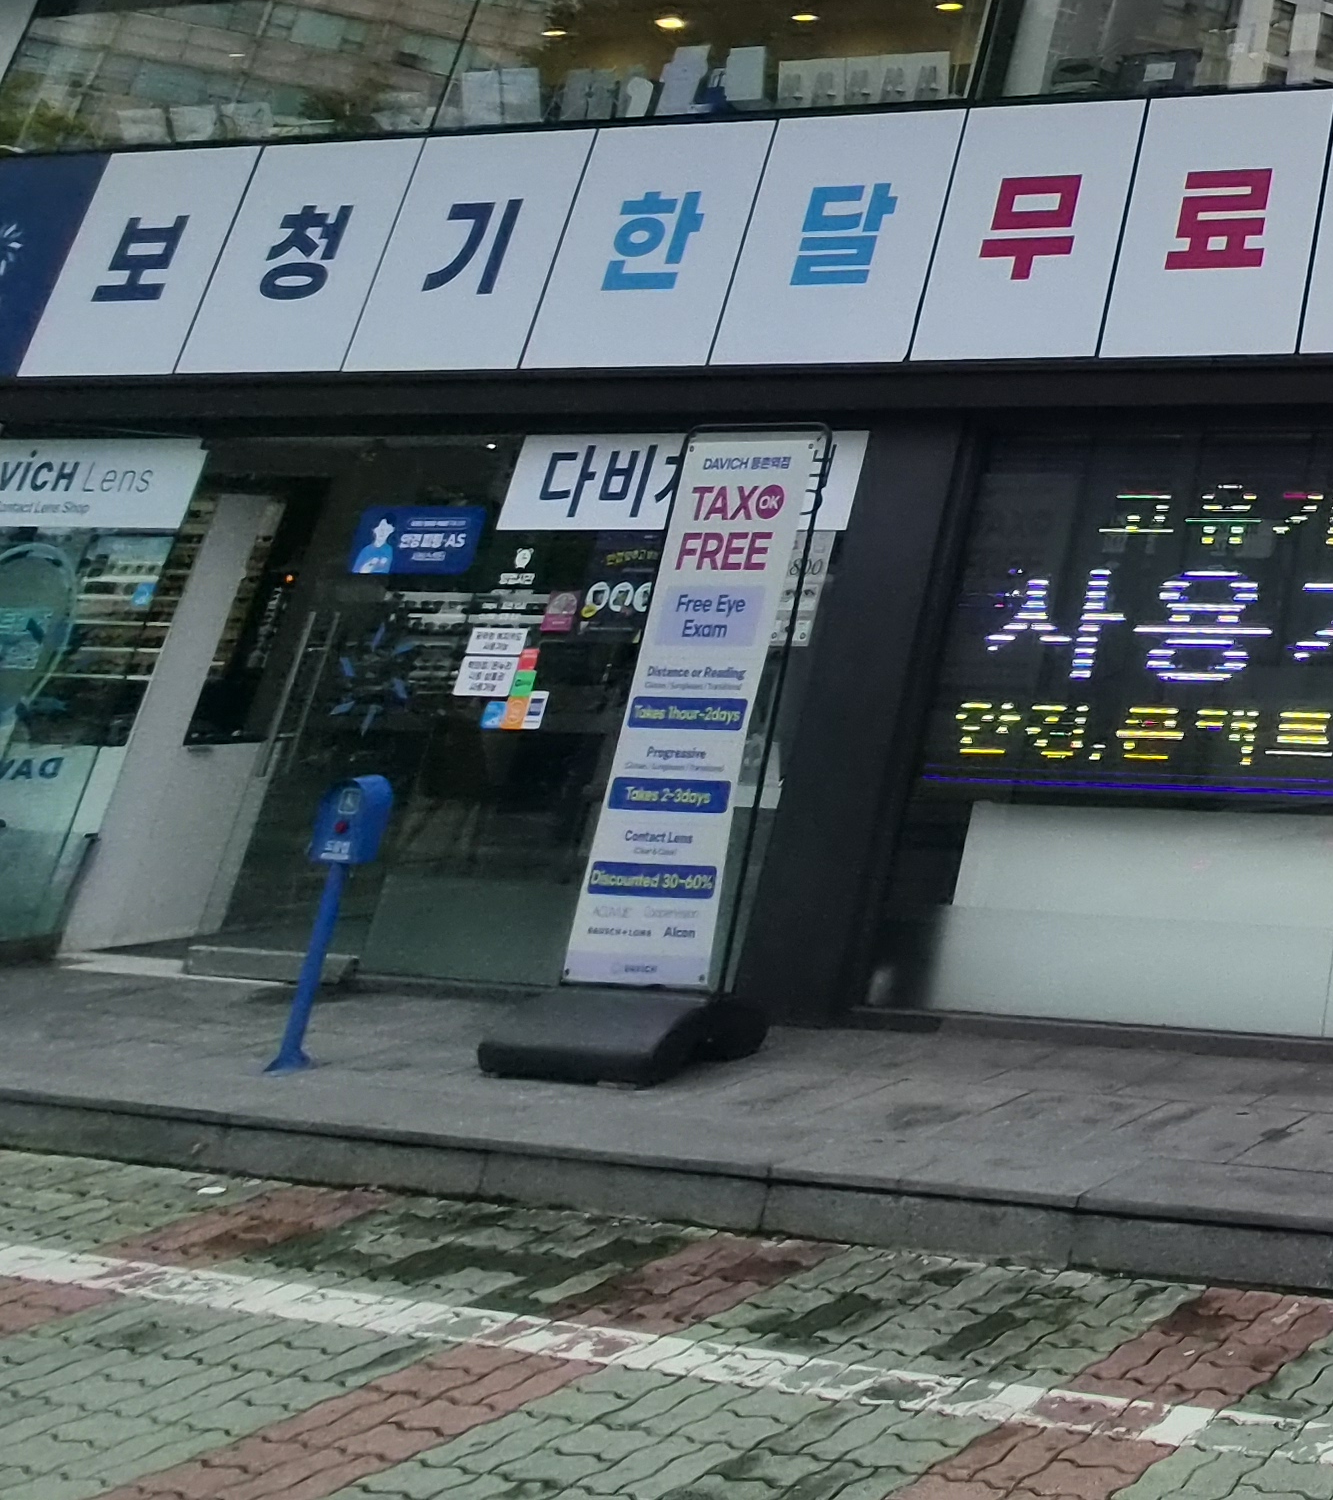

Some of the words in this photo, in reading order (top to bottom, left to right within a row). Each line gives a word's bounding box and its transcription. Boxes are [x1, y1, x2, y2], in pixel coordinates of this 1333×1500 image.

[703, 457, 749, 470] DAVICH
[82, 461, 154, 493] Lens
[691, 485, 760, 521] TAX
[758, 495, 781, 510] OK
[675, 531, 775, 571] FREE
[675, 594, 711, 613] Free
[716, 594, 747, 618] Eye
[681, 619, 728, 638] Exam
[647, 666, 690, 678] Distance
[634, 704, 666, 720] Takes
[625, 786, 659, 802] Takes
[625, 830, 666, 843] Contact
[590, 869, 660, 888] Discounted
